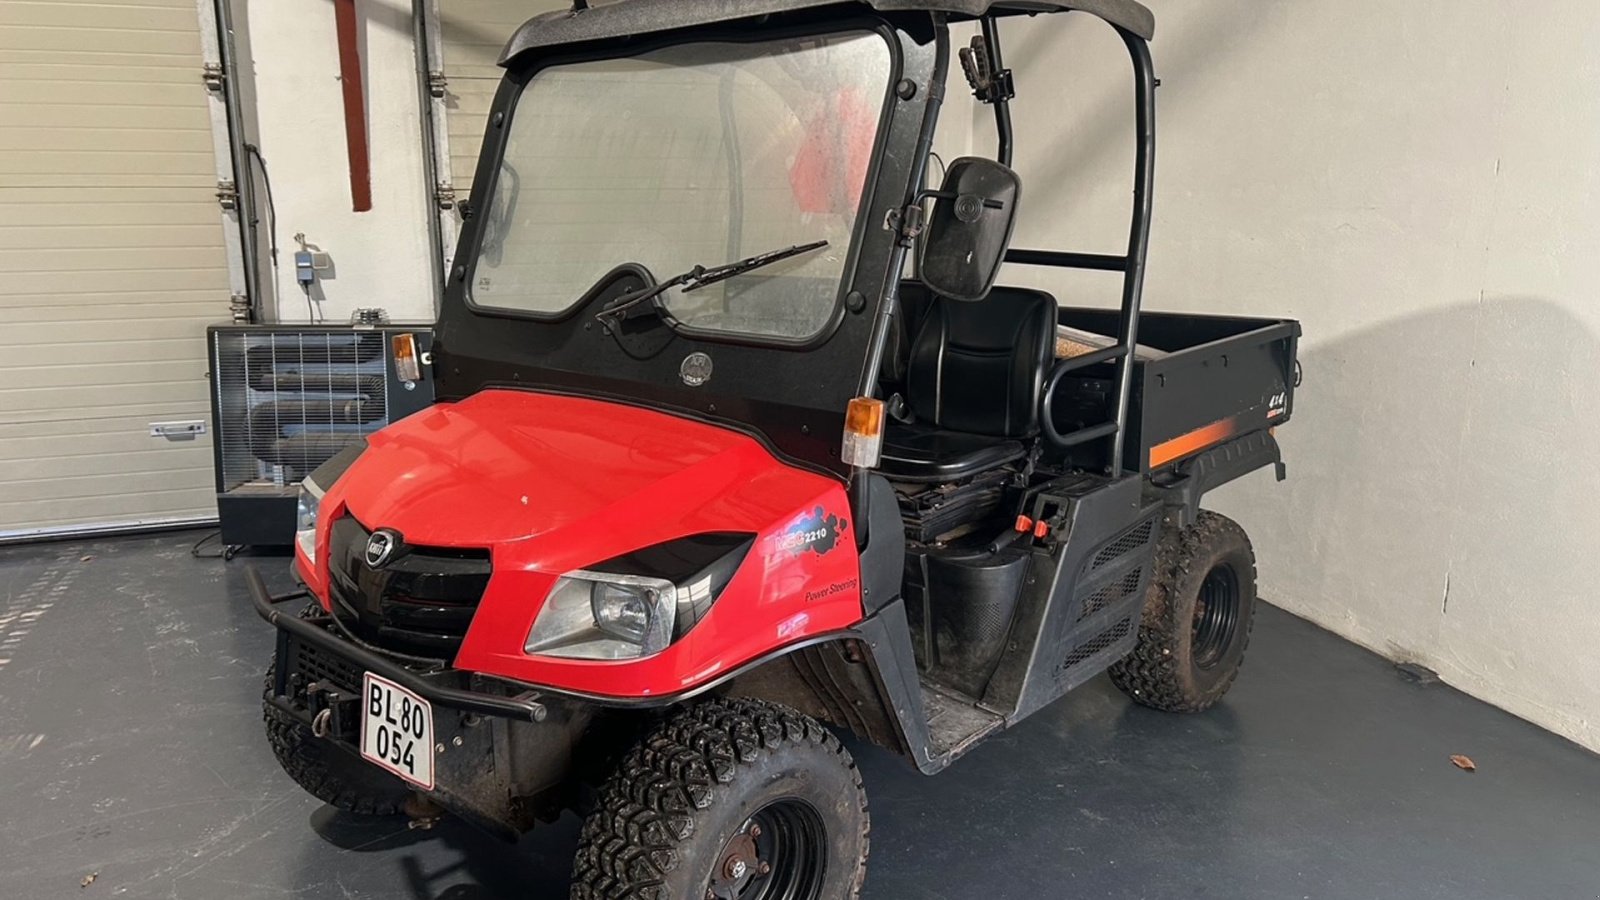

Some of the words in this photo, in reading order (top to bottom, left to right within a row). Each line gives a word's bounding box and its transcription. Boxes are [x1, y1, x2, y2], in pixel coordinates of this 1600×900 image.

[805, 588, 829, 602] Power
[829, 578, 857, 595] Steering
[377, 725, 414, 775] 054
